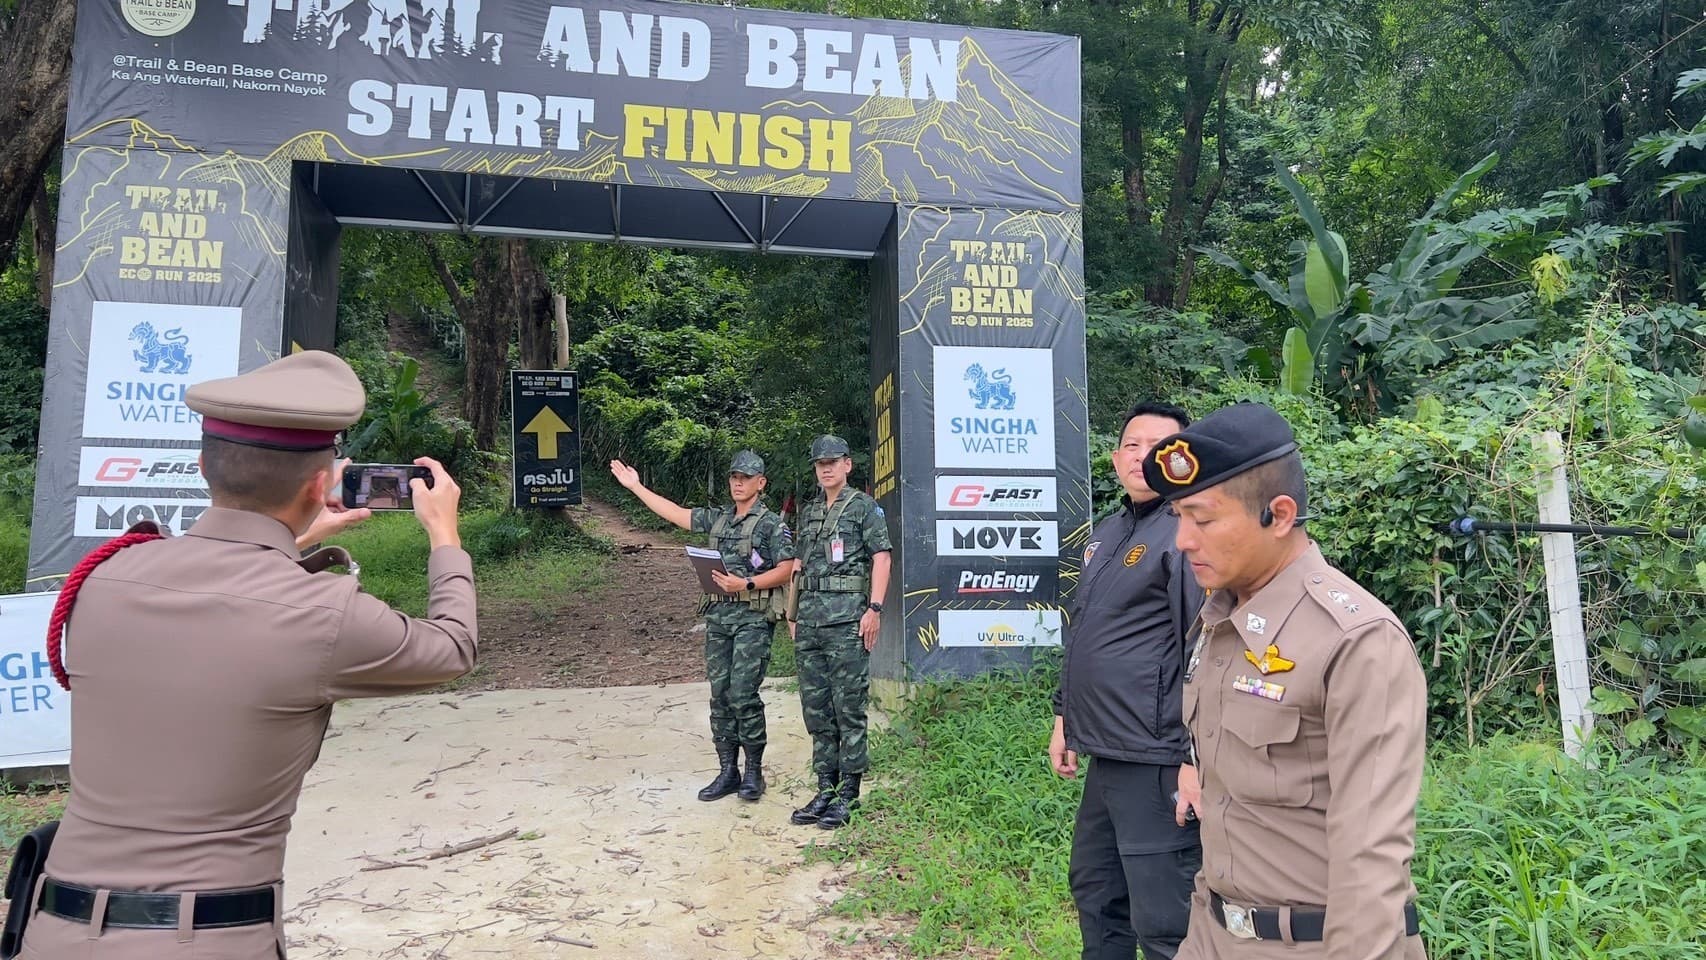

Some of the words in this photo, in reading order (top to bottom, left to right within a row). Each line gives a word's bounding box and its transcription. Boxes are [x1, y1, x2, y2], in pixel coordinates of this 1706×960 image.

[164, 0, 192, 10] BEAN
[537, 6, 711, 82] AND
[745, 23, 960, 102] BEAN
[113, 54, 162, 70] @Trail
[166, 59, 180, 71] &
[183, 60, 227, 75] Bean
[232, 64, 274, 79] Base
[278, 68, 328, 85] Camp
[111, 70, 130, 80] Ka
[133, 71, 161, 84] Ang
[164, 73, 229, 89] Waterfall,
[232, 79, 281, 92] Nakorn
[284, 84, 327, 96] Nayok
[347, 79, 594, 151] START
[622, 103, 852, 174] FINISH
[125, 185, 227, 214] TRAIL
[139, 211, 207, 239] AND
[120, 236, 223, 269] BEAN
[950, 240, 1032, 264] TRAIL
[155, 270, 183, 281] RUN
[187, 271, 221, 283] 2025
[963, 264, 1018, 288] AND
[951, 287, 1033, 315] BEAN
[981, 316, 1002, 326] RUN
[1006, 316, 1034, 327] 2025
[107, 381, 186, 402] SING
[951, 417, 1038, 435] SINGHA
[962, 437, 1029, 454] WATER
[95, 457, 200, 482] G-FAS
[523, 468, 574, 485] ตรงไป
[948, 485, 1043, 507] G-FAST
[958, 571, 1040, 593] ProEngy
[977, 633, 994, 642] UV
[997, 632, 1025, 642] Ultra
